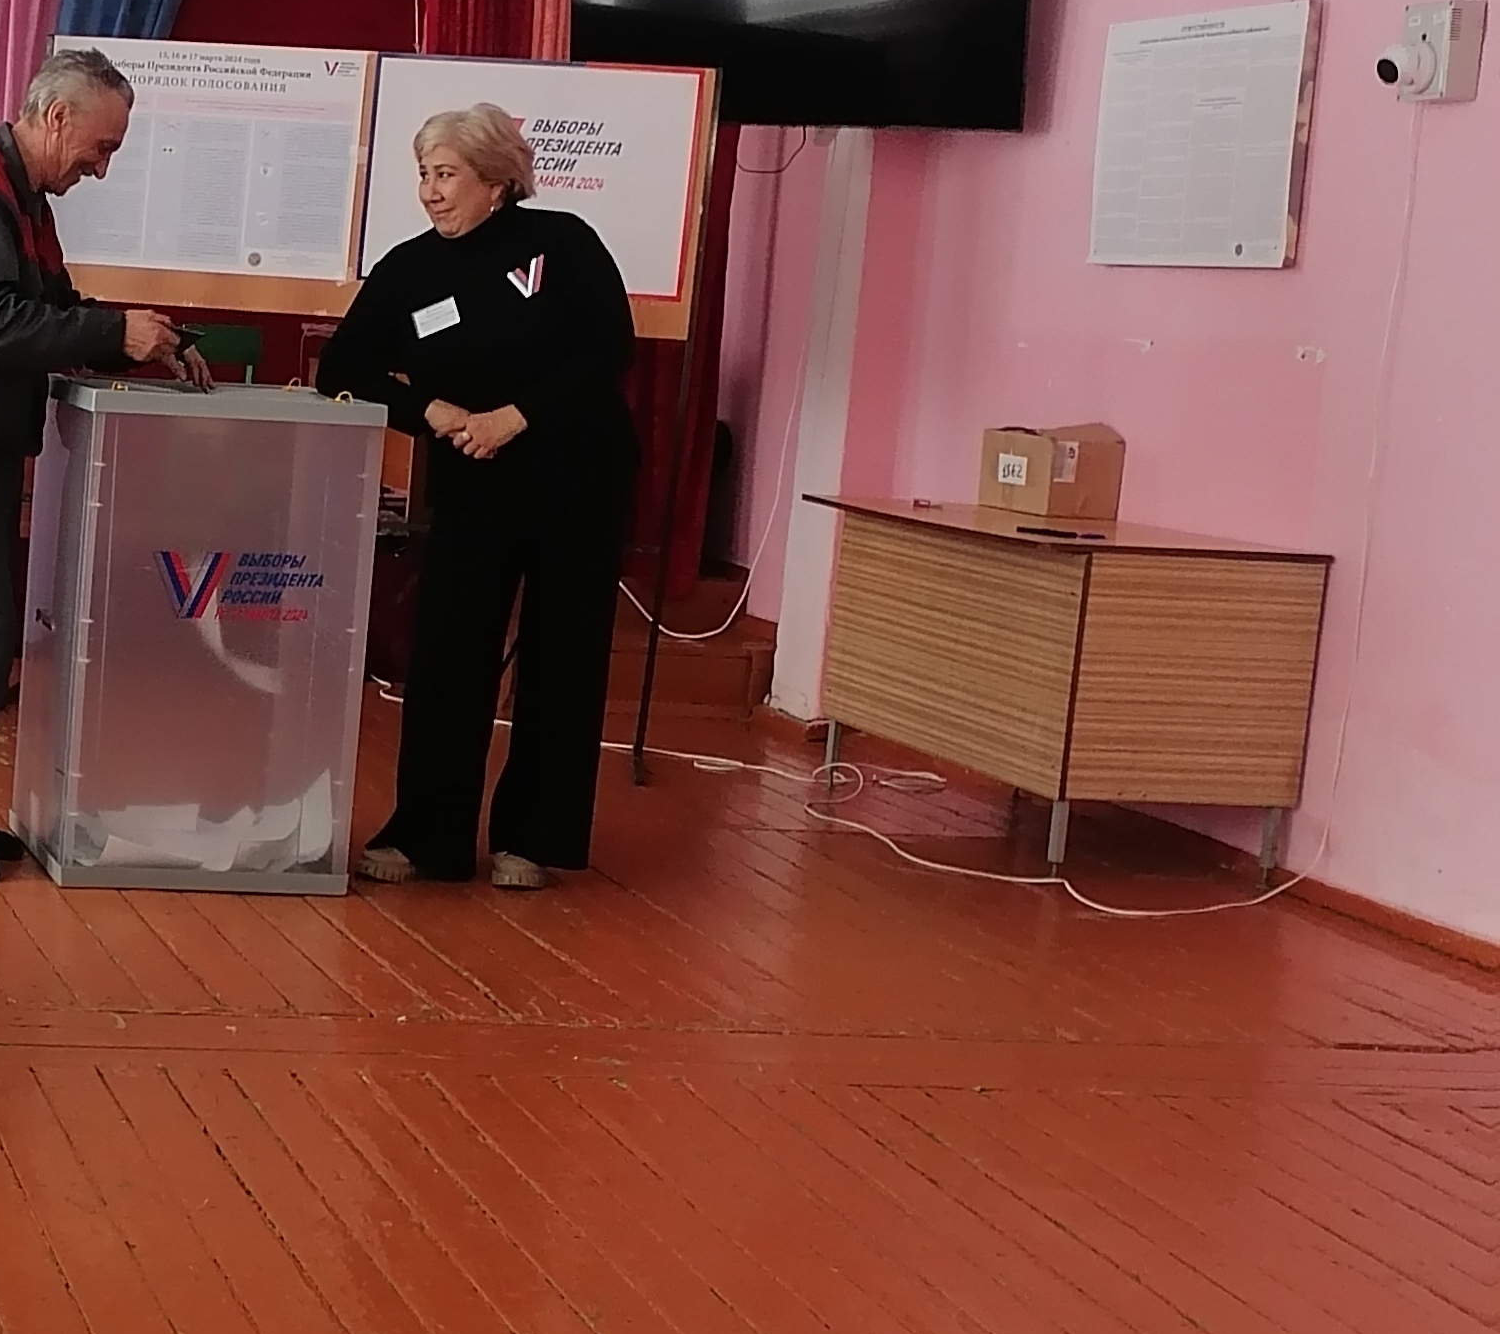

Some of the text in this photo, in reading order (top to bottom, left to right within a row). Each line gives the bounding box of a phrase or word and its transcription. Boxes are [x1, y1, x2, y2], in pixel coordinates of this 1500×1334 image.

[203, 63, 258, 76] Российской
[191, 77, 287, 93] ГОЛОСОВАНИЯ
[532, 119, 605, 136] ВЫБОРЫ
[534, 157, 578, 172] ССИИ
[536, 175, 576, 189] МАРТА
[238, 553, 306, 569] ВЫБОРЫ
[229, 571, 324, 589] ПРЕЗИДЕНТА
[220, 589, 283, 605] РОССИИ
